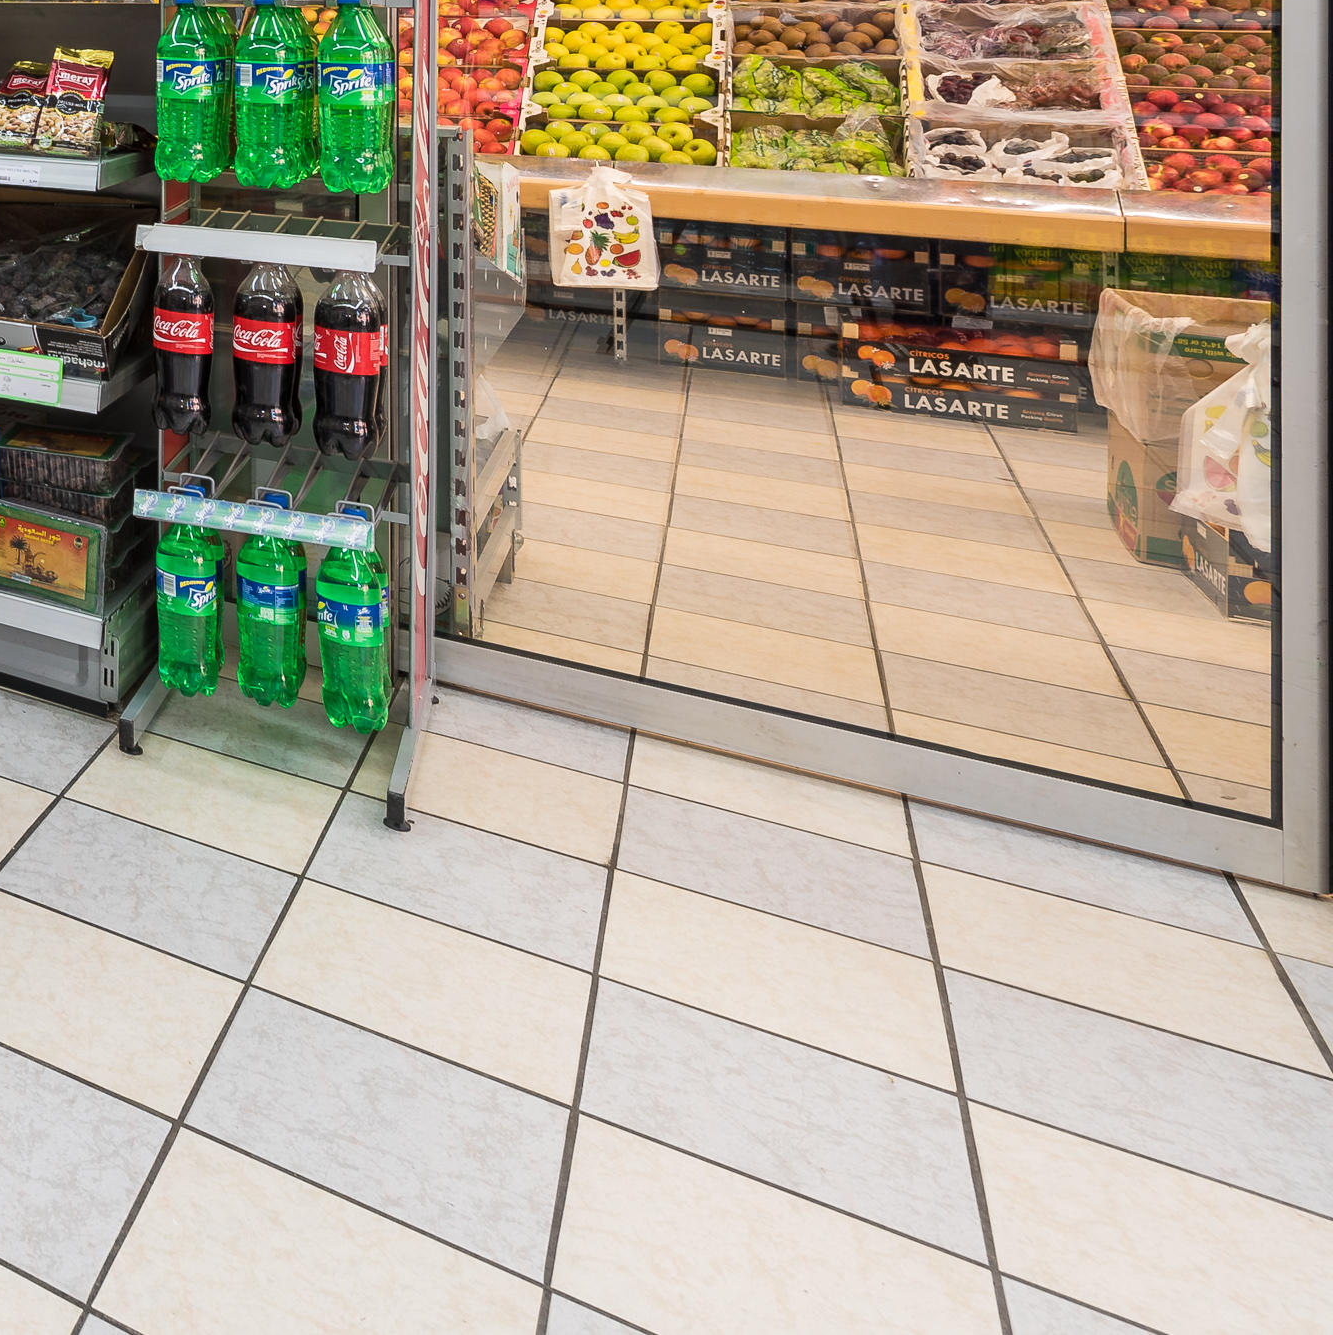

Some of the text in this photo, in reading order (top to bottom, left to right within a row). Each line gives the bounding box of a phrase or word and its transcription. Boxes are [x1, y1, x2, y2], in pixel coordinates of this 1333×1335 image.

[13, 76, 45, 89] meray
[60, 71, 97, 85] meray
[176, 72, 213, 91] Sprite
[333, 74, 374, 96] Sprite
[701, 270, 781, 288] LASARTE
[838, 282, 925, 302] LASARTE
[990, 294, 1085, 316] LASARTE
[154, 314, 203, 339] Coca-Cola
[549, 309, 616, 326] LASARTE
[234, 324, 284, 348] Coca-Cola
[702, 347, 782, 367] LASARTE
[909, 357, 1015, 383] LASARTE
[904, 393, 1009, 420] LASARTE
[1195, 555, 1228, 596] LASARTE
